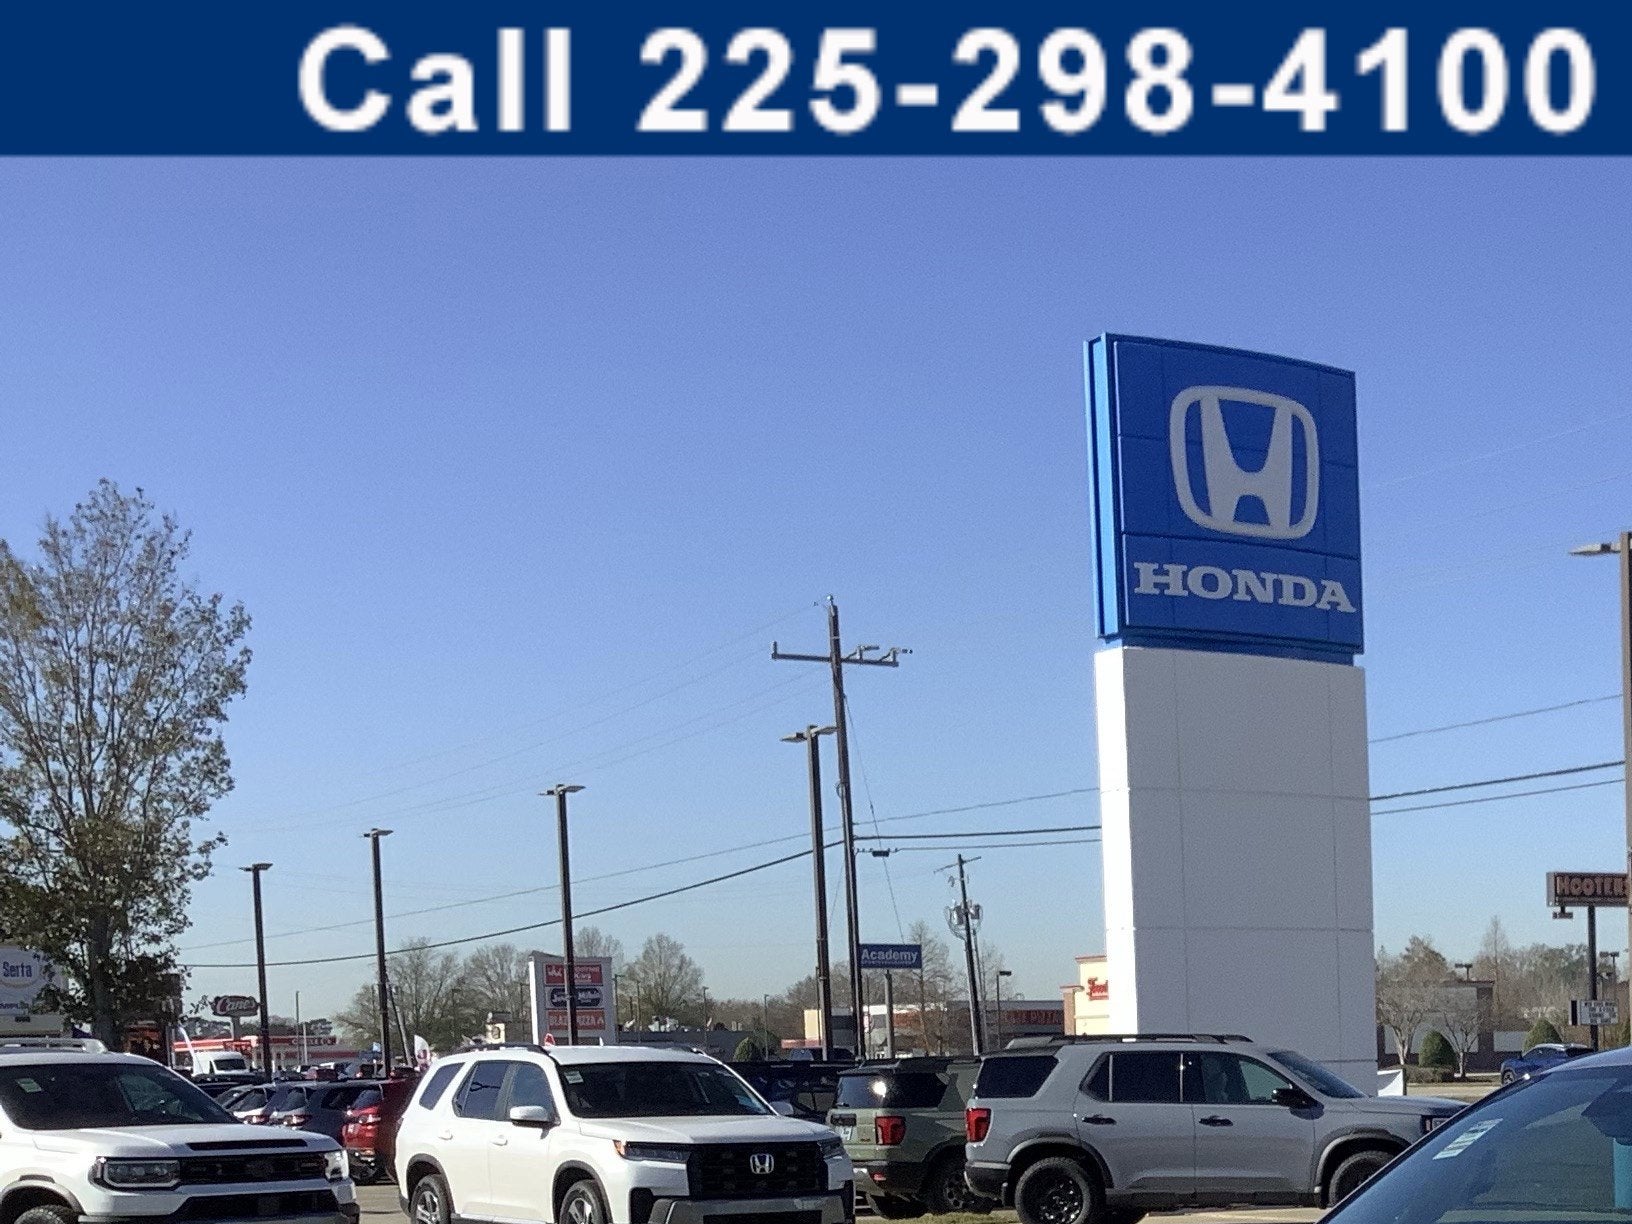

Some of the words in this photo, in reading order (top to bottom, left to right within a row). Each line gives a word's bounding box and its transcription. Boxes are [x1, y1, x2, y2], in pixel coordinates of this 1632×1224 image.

[1133, 561, 1357, 613] HONDA
[861, 949, 918, 963] Academy
[2, 961, 33, 978] Serta
